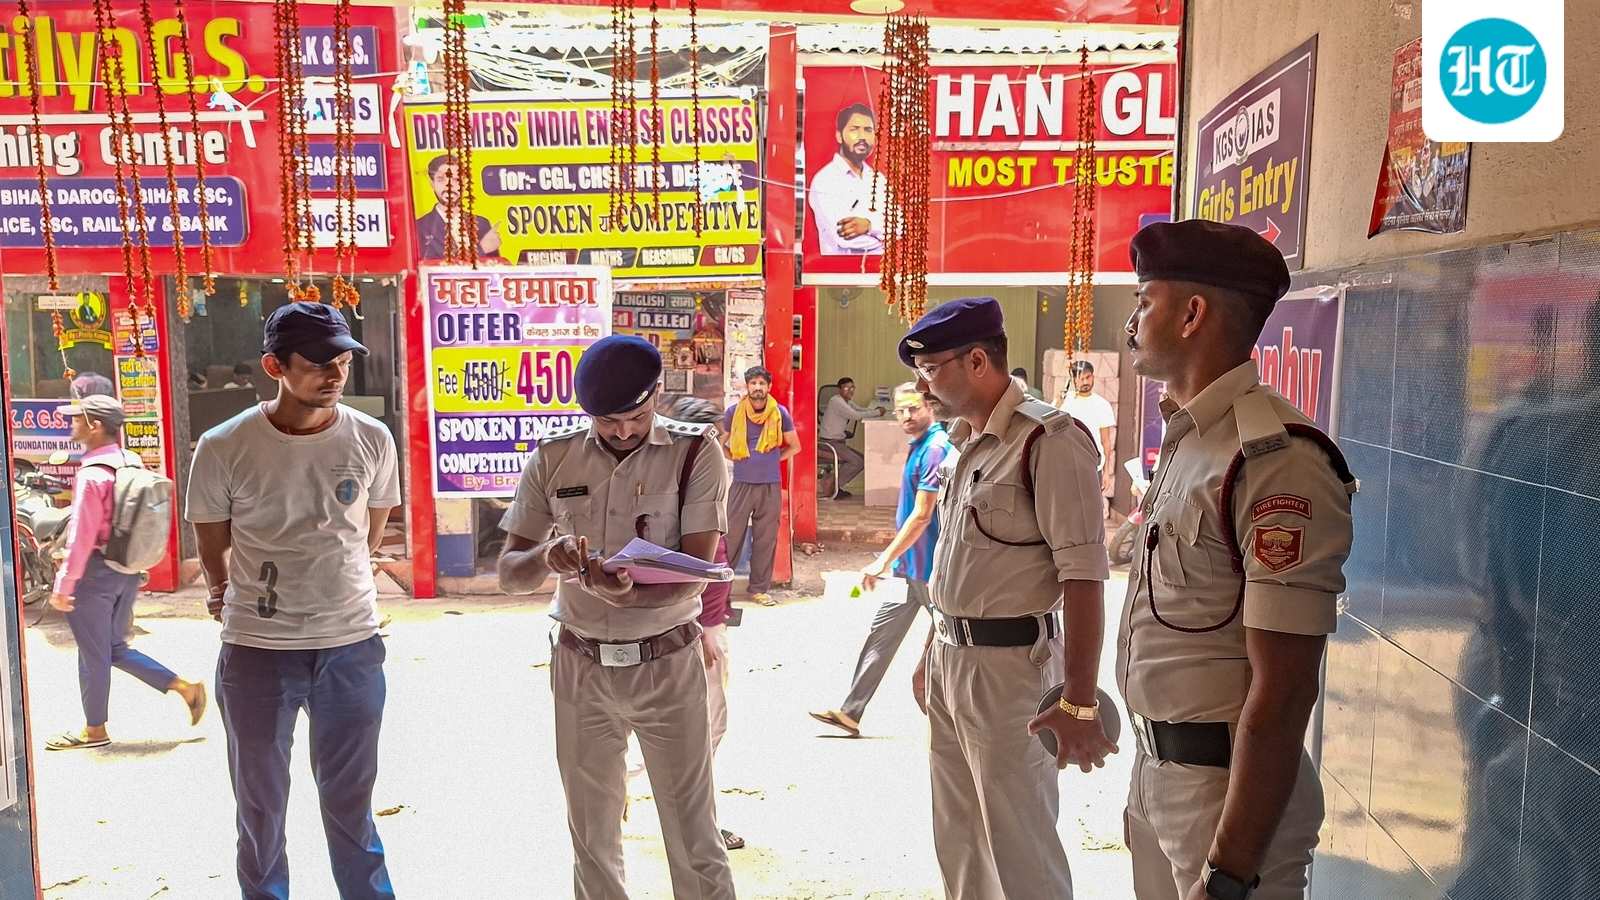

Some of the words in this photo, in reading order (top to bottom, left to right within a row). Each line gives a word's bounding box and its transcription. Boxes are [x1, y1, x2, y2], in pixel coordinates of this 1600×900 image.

[322, 35, 334, 65] &
[890, 74, 1064, 137] HAN
[528, 110, 582, 147] INDIA
[586, 108, 665, 146] ENLSH
[671, 106, 753, 144] CLASSES
[1251, 101, 1275, 144] IAS
[100, 126, 225, 167] Centre
[1215, 127, 1234, 165] KGS
[501, 168, 537, 191] for:-
[539, 167, 577, 191] CGL,
[948, 157, 1037, 188] MOST
[0, 189, 54, 205] BIHAR
[139, 188, 190, 204] BIHAR
[193, 187, 233, 206] SSC,
[1198, 179, 1235, 223] Girls
[1239, 156, 1298, 214] Entry
[0, 217, 36, 236] ICE,
[179, 216, 228, 232] BANK
[299, 214, 380, 232] ENGSH
[507, 205, 593, 235] SPOKEN
[616, 202, 759, 232] COMPETITIVE
[641, 248, 695, 266] REASONING
[714, 246, 746, 264] GK/GS
[622, 294, 665, 307] ENGLISH
[437, 313, 521, 342] OFFER
[437, 367, 458, 395] Fee
[23, 409, 36, 429] &
[439, 417, 516, 442] SPOKEN
[14, 440, 57, 451] FOUNDATION
[440, 452, 534, 474] COMPETITIV
[1256, 501, 1272, 513] FIRE
[1273, 499, 1305, 510] FIGHTER
[257, 561, 278, 618] 3
